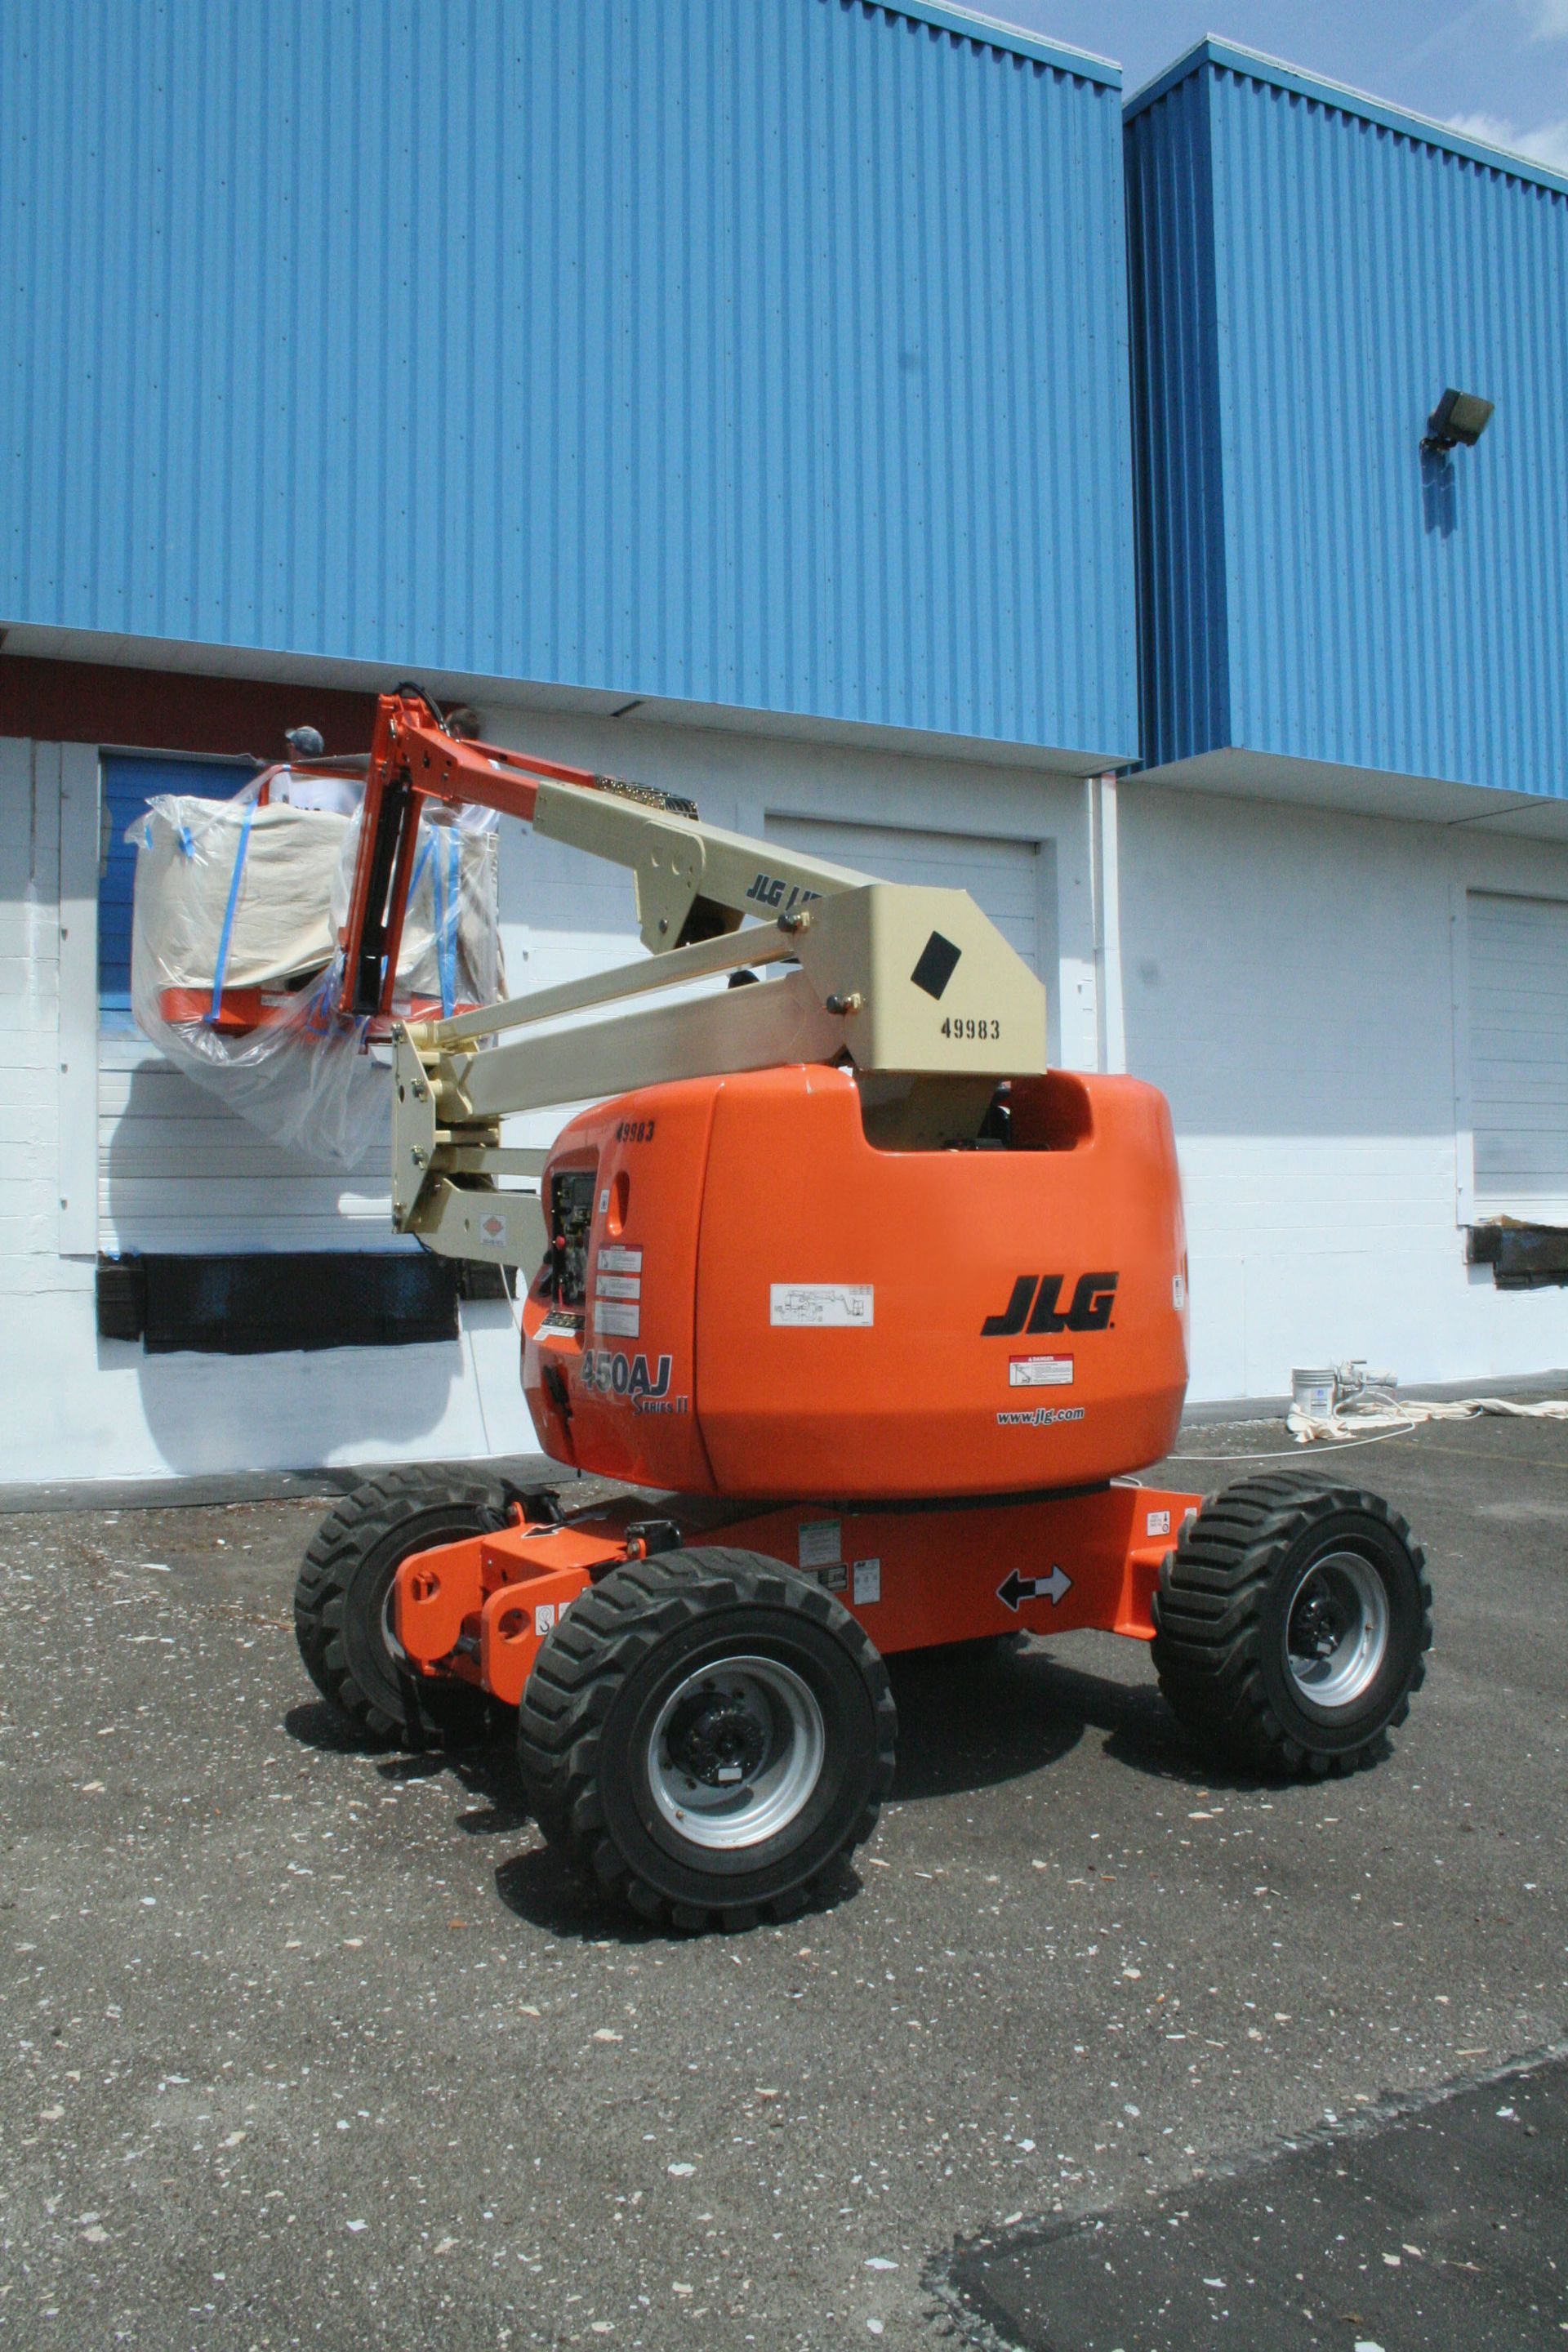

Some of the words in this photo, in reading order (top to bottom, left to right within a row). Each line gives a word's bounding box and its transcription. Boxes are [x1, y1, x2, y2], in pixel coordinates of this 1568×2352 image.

[746, 873, 786, 908] JLG
[941, 1017, 1000, 1040] 49983
[617, 1121, 654, 1143] 49983
[981, 1272, 1119, 1337] JLG
[581, 1349, 673, 1398] 450AJ
[997, 1407, 1085, 1426] www.jlg.com
